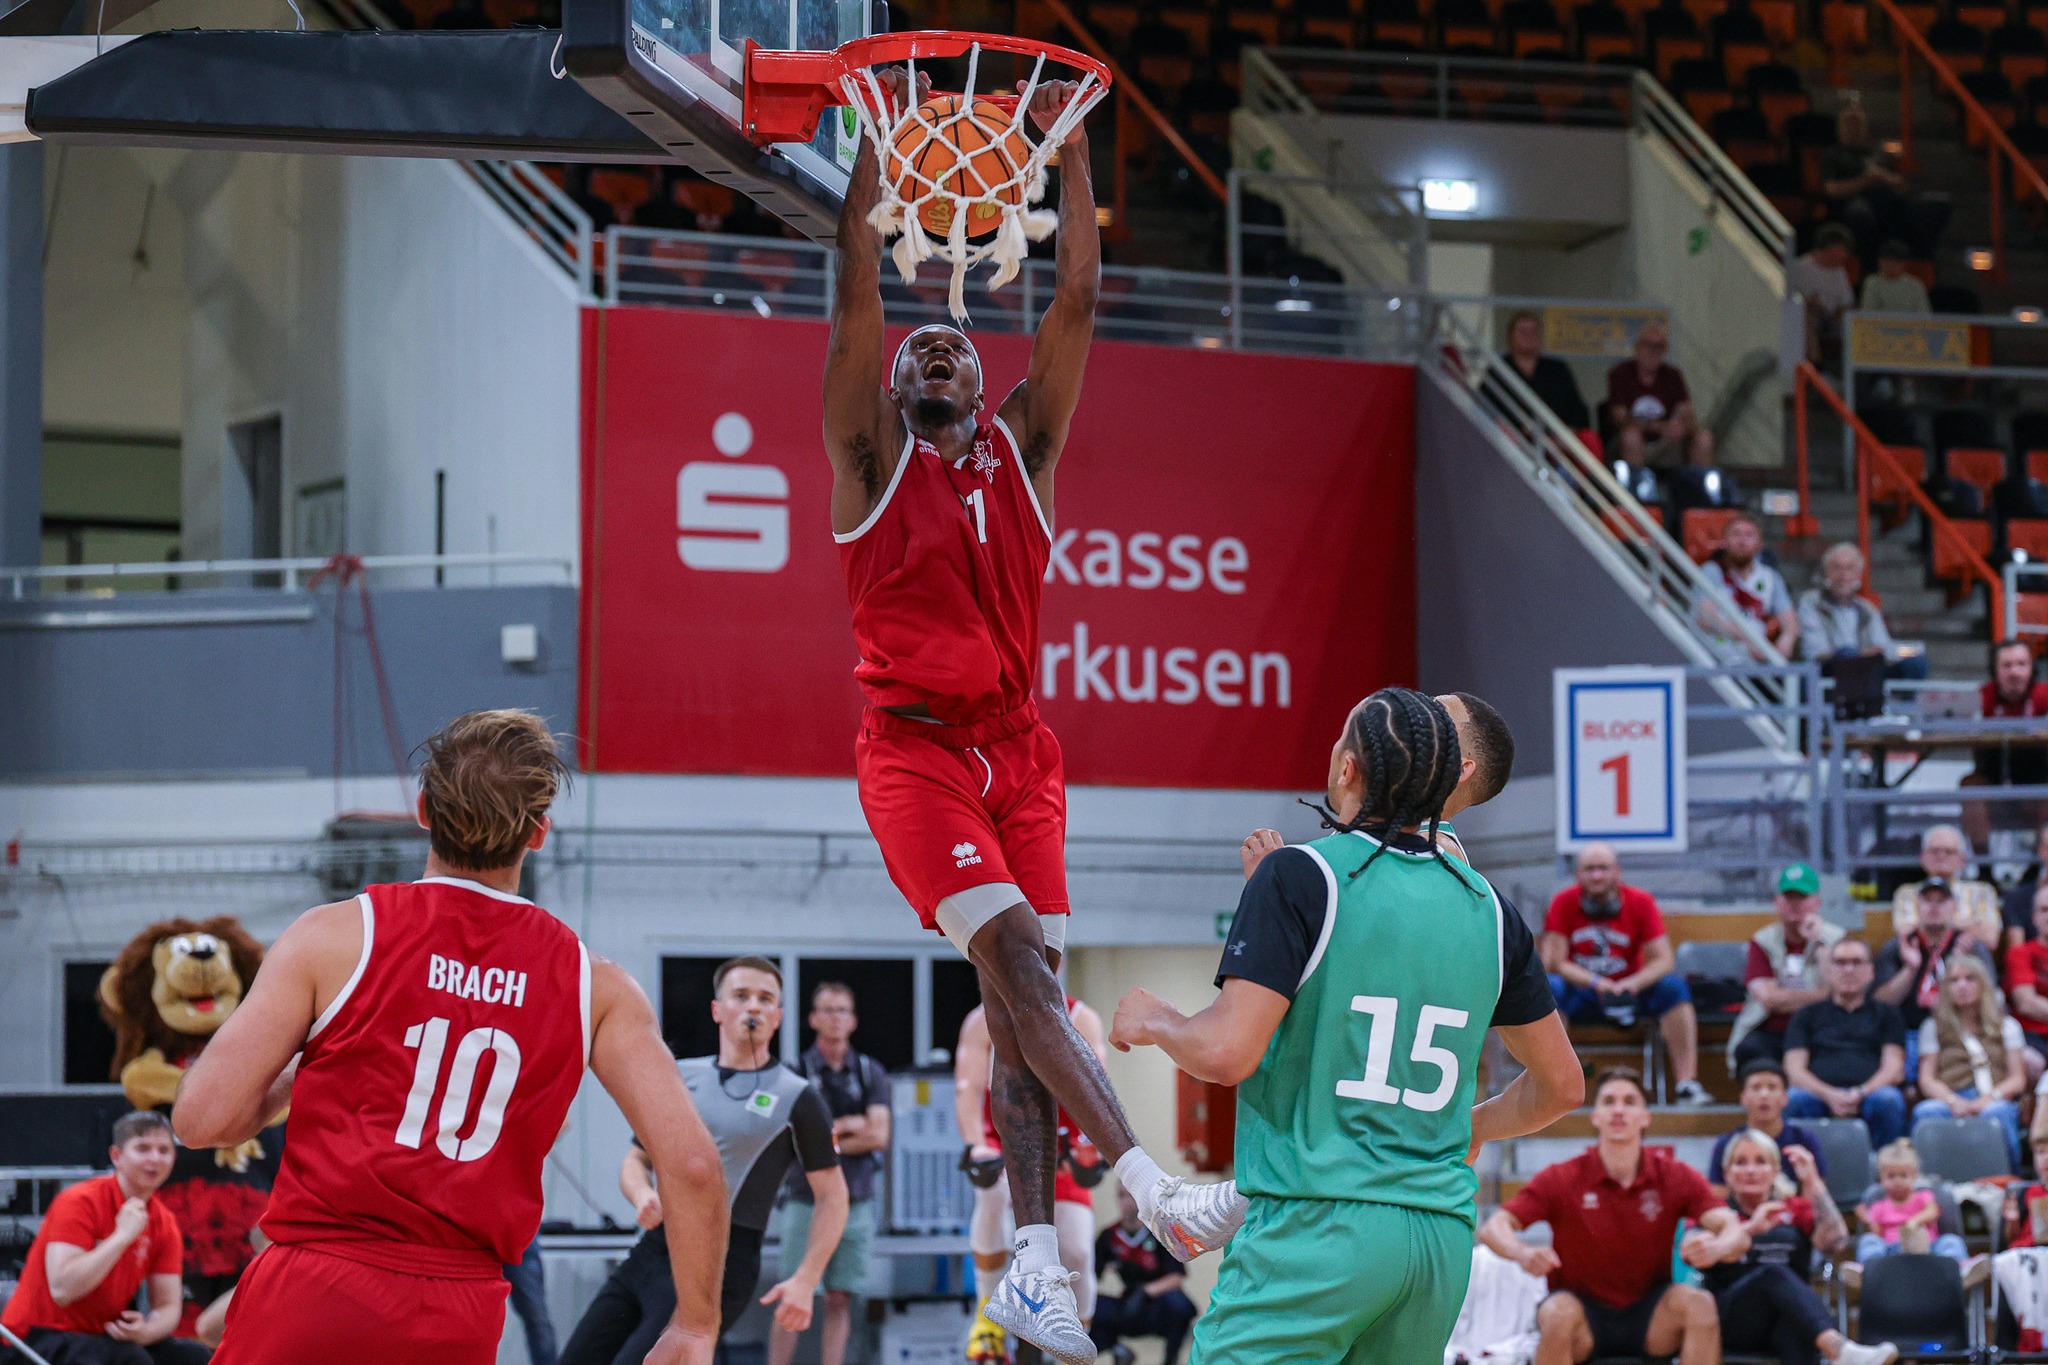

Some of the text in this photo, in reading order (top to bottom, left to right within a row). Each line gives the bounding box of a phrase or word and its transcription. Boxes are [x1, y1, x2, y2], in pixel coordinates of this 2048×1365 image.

[957, 489, 988, 544] 1
[1044, 527, 1249, 594] kasse
[1041, 621, 1291, 707] rkusen
[1583, 721, 1656, 740] BLOCK
[1600, 753, 1630, 817] 1
[956, 855, 982, 868] errea
[427, 953, 527, 1008] BRACH
[1335, 995, 1469, 1112] 15
[394, 1016, 522, 1162] 10
